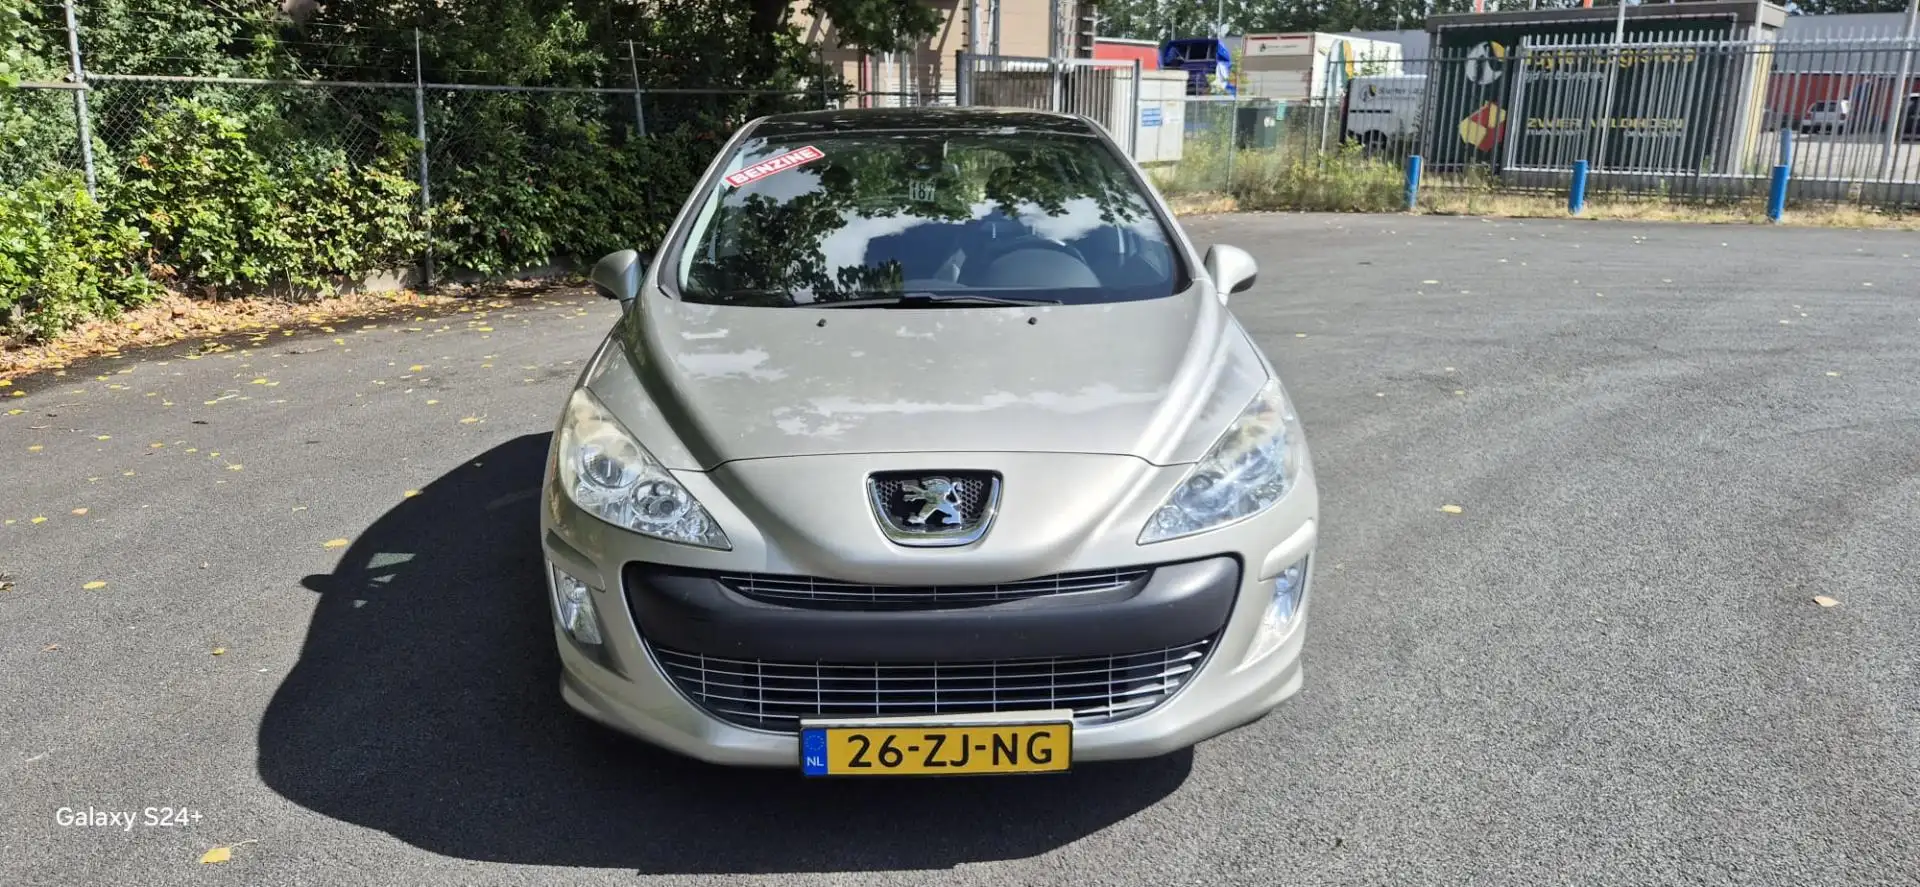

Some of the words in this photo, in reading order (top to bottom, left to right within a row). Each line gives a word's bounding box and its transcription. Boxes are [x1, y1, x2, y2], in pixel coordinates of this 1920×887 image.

[729, 148, 818, 184] BENZINE
[911, 182, 935, 200] 187
[806, 756, 824, 767] NL
[847, 731, 1053, 768] 26-ZJ-NG
